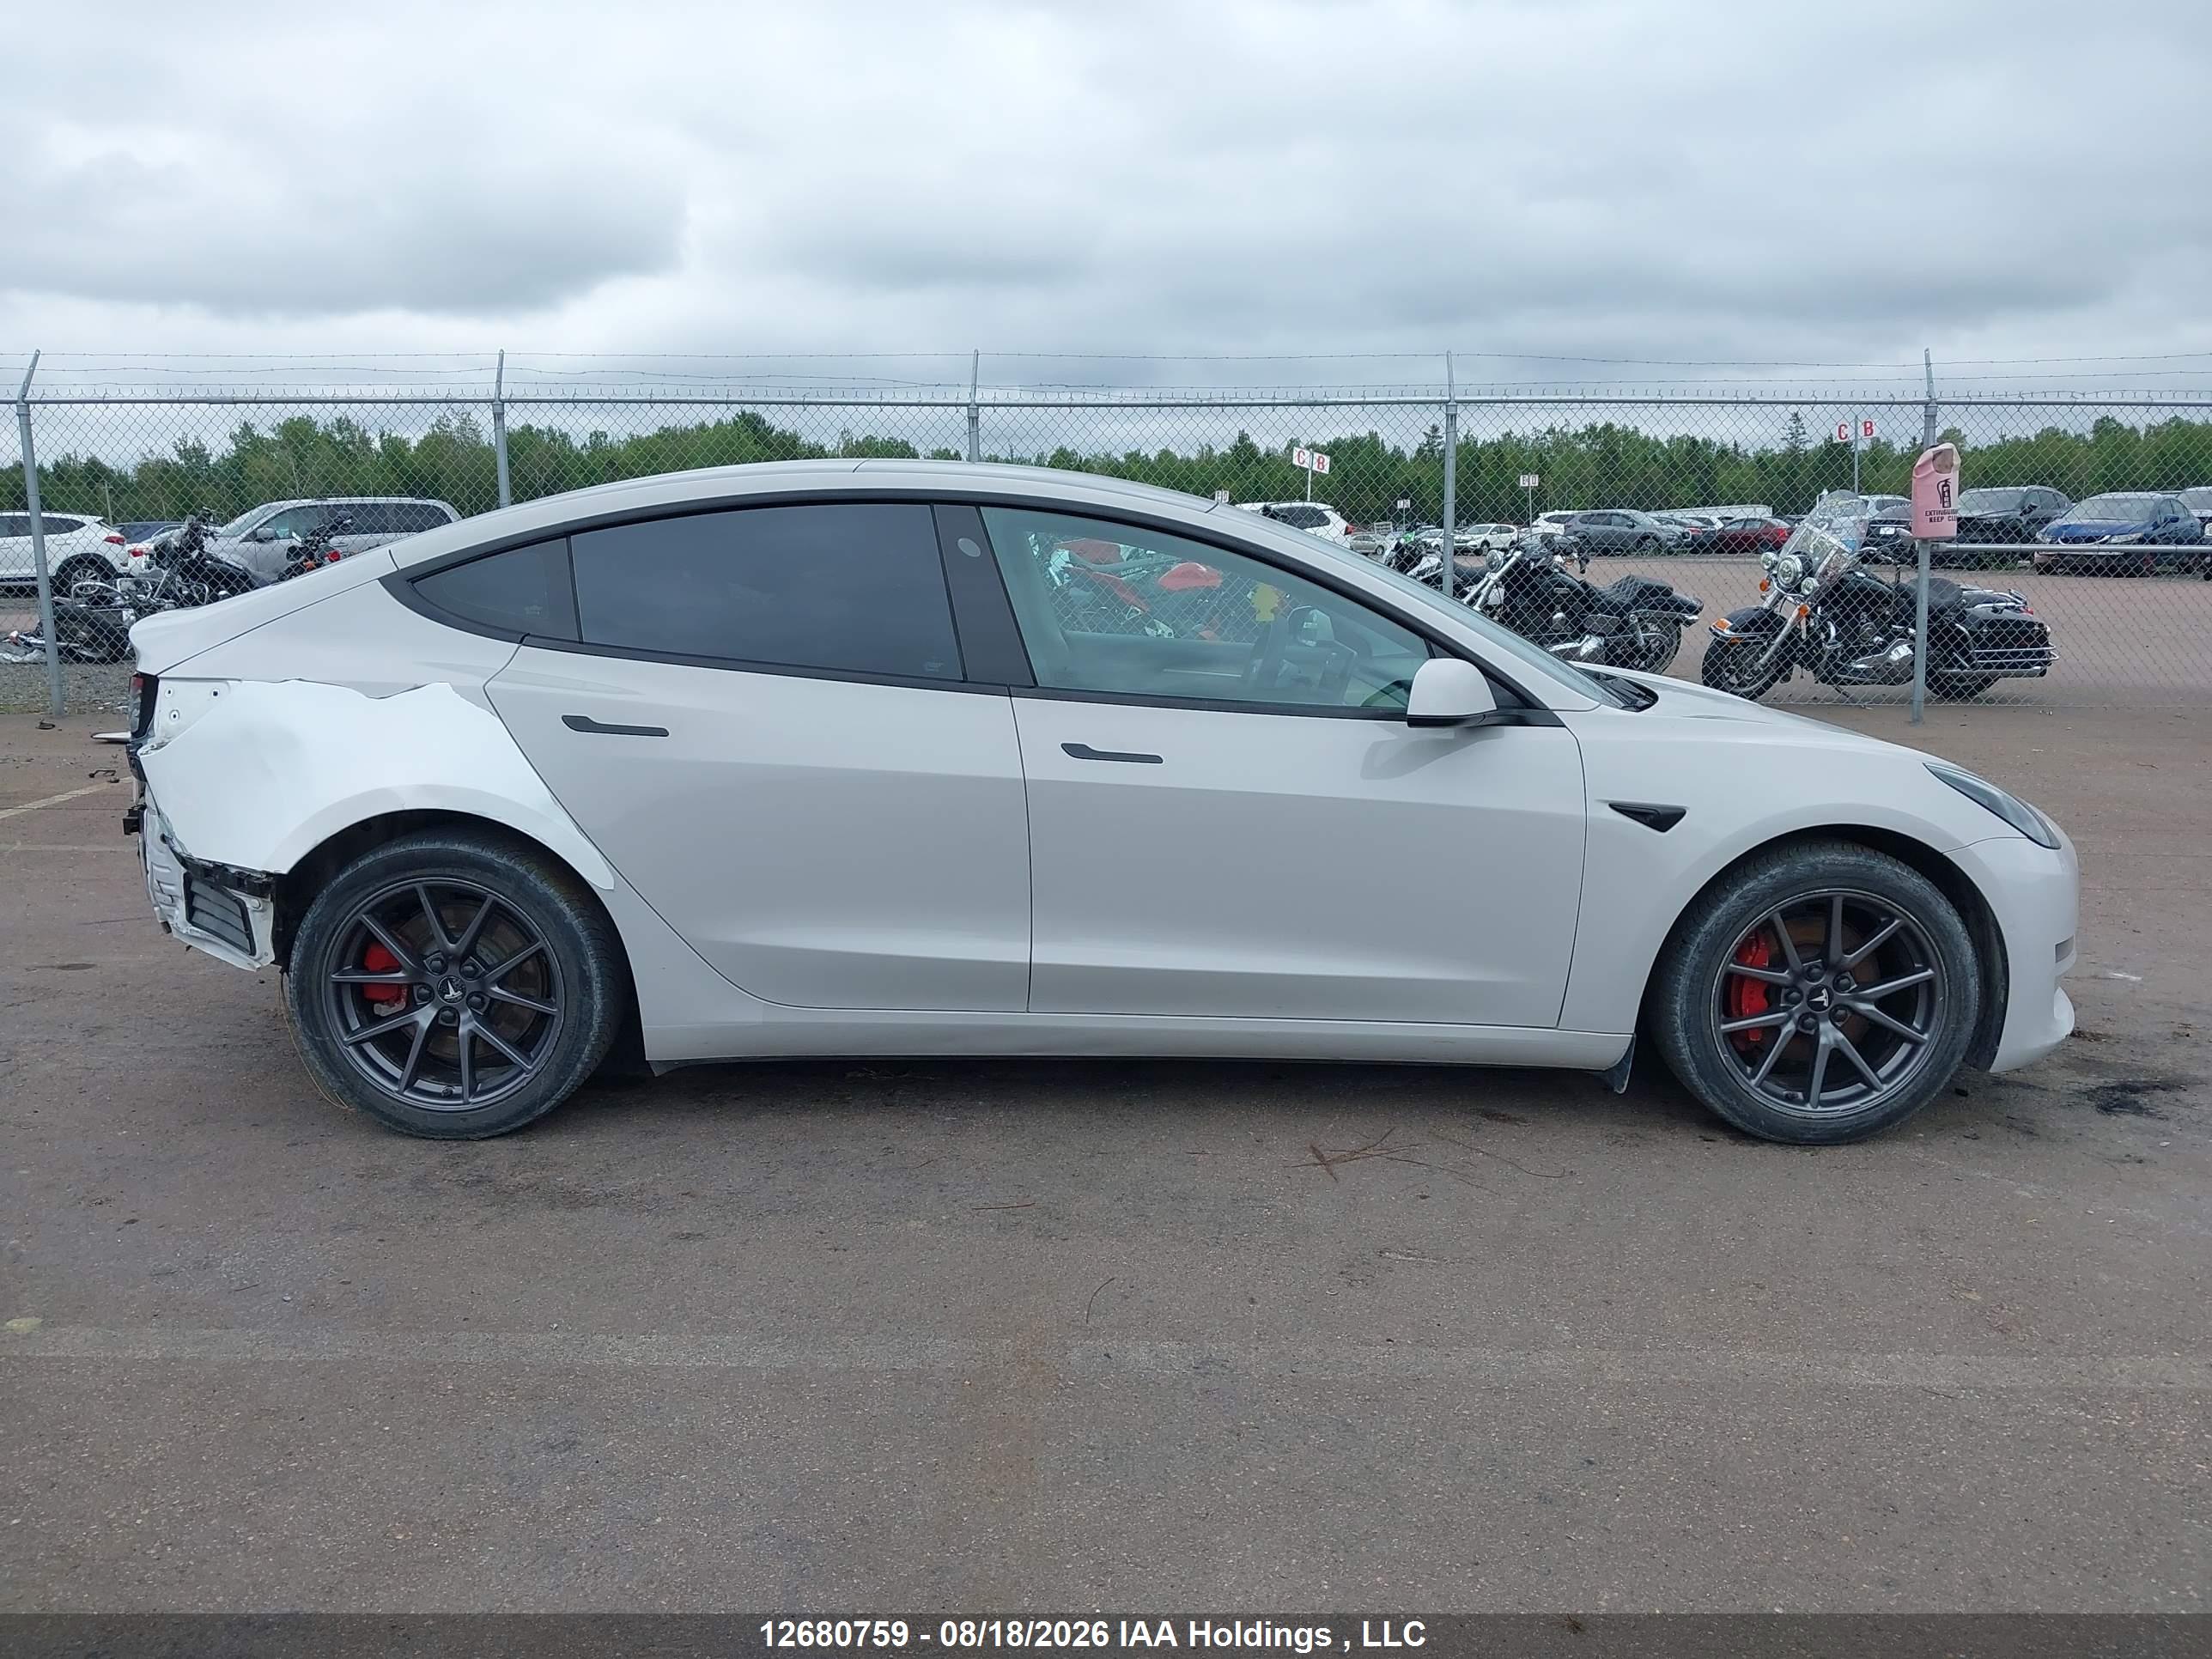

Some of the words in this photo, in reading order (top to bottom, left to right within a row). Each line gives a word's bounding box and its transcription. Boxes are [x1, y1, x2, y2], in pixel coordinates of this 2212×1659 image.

[1838, 424, 1848, 440] C
[1863, 421, 1874, 436] B
[1297, 450, 1305, 465] C
[1317, 455, 1325, 471] B
